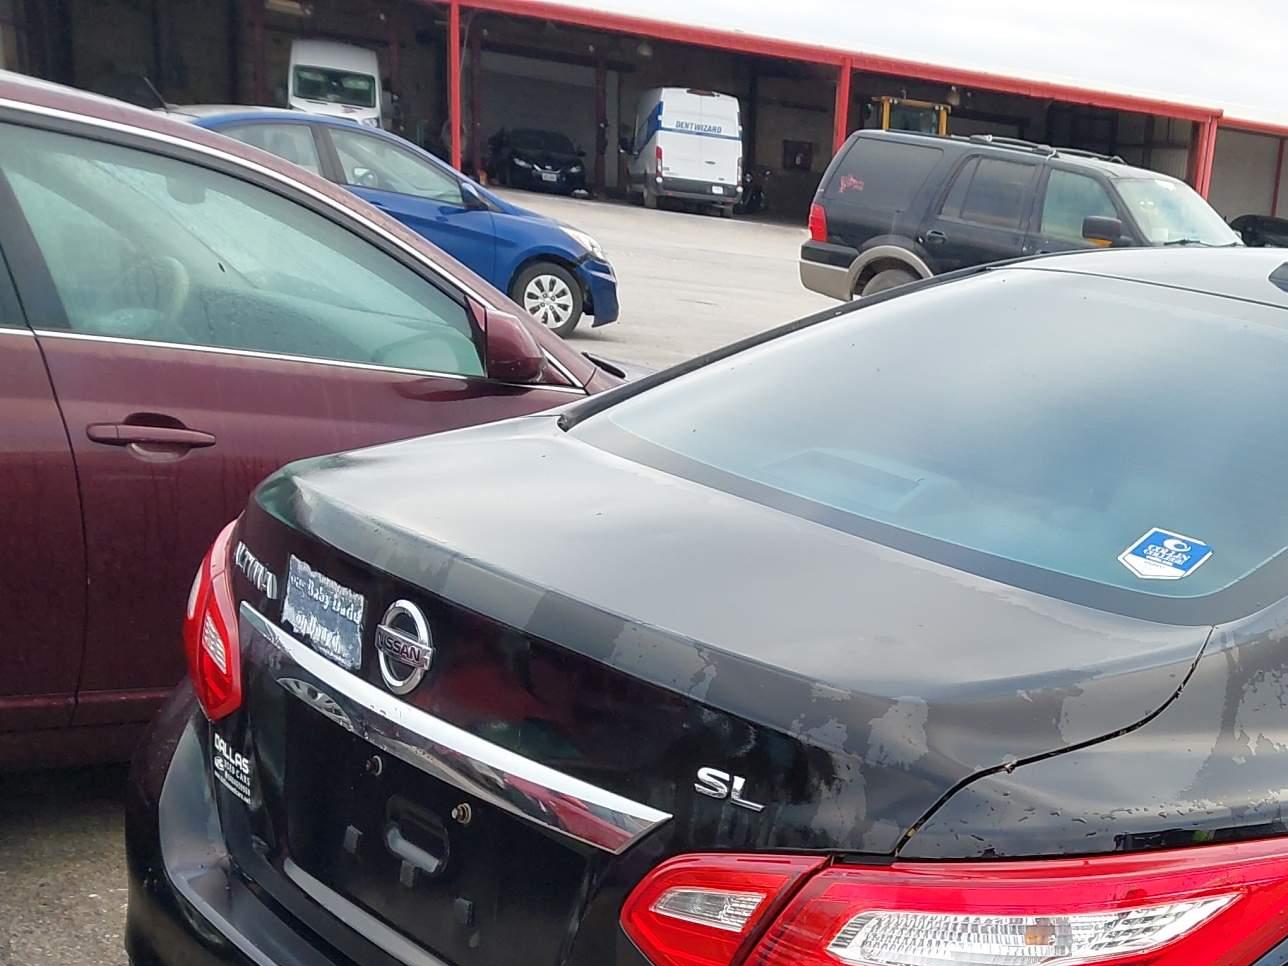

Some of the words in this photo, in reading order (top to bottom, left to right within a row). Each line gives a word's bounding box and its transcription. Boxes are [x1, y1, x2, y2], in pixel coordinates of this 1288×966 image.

[676, 120, 693, 130] DENT
[694, 123, 722, 133] WIZARD
[377, 630, 421, 662] NISSAN
[213, 732, 250, 776] DALLAS
[694, 766, 766, 813] SL
